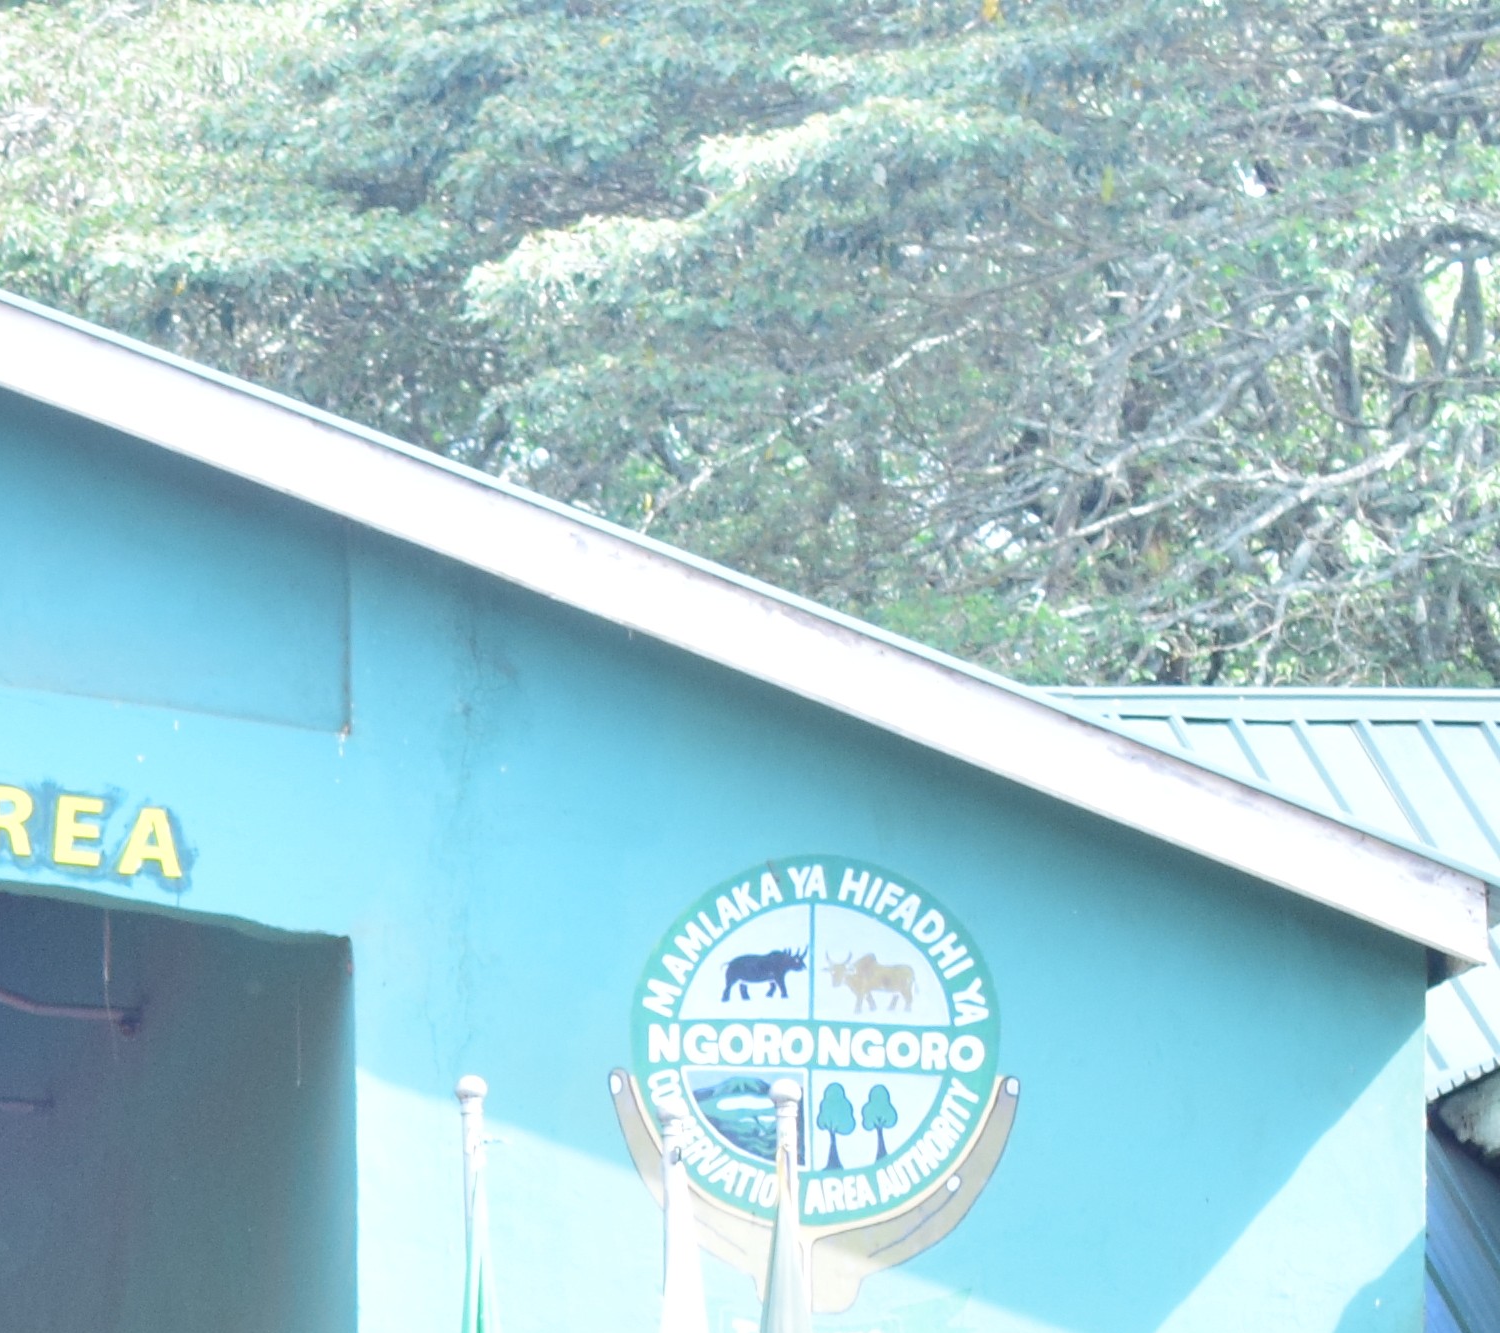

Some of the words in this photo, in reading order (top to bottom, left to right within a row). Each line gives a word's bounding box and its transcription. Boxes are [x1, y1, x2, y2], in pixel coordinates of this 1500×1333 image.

[642, 872, 783, 1018] MAMLAKA
[787, 864, 826, 900] YA
[837, 868, 975, 978] HIFADHI
[951, 976, 989, 1027] YA
[648, 1023, 985, 1073] NGORONGORO
[647, 1068, 779, 1208] COERVATIO
[804, 1178, 876, 1214] AREA
[876, 1077, 979, 1207] AUTHORITY
